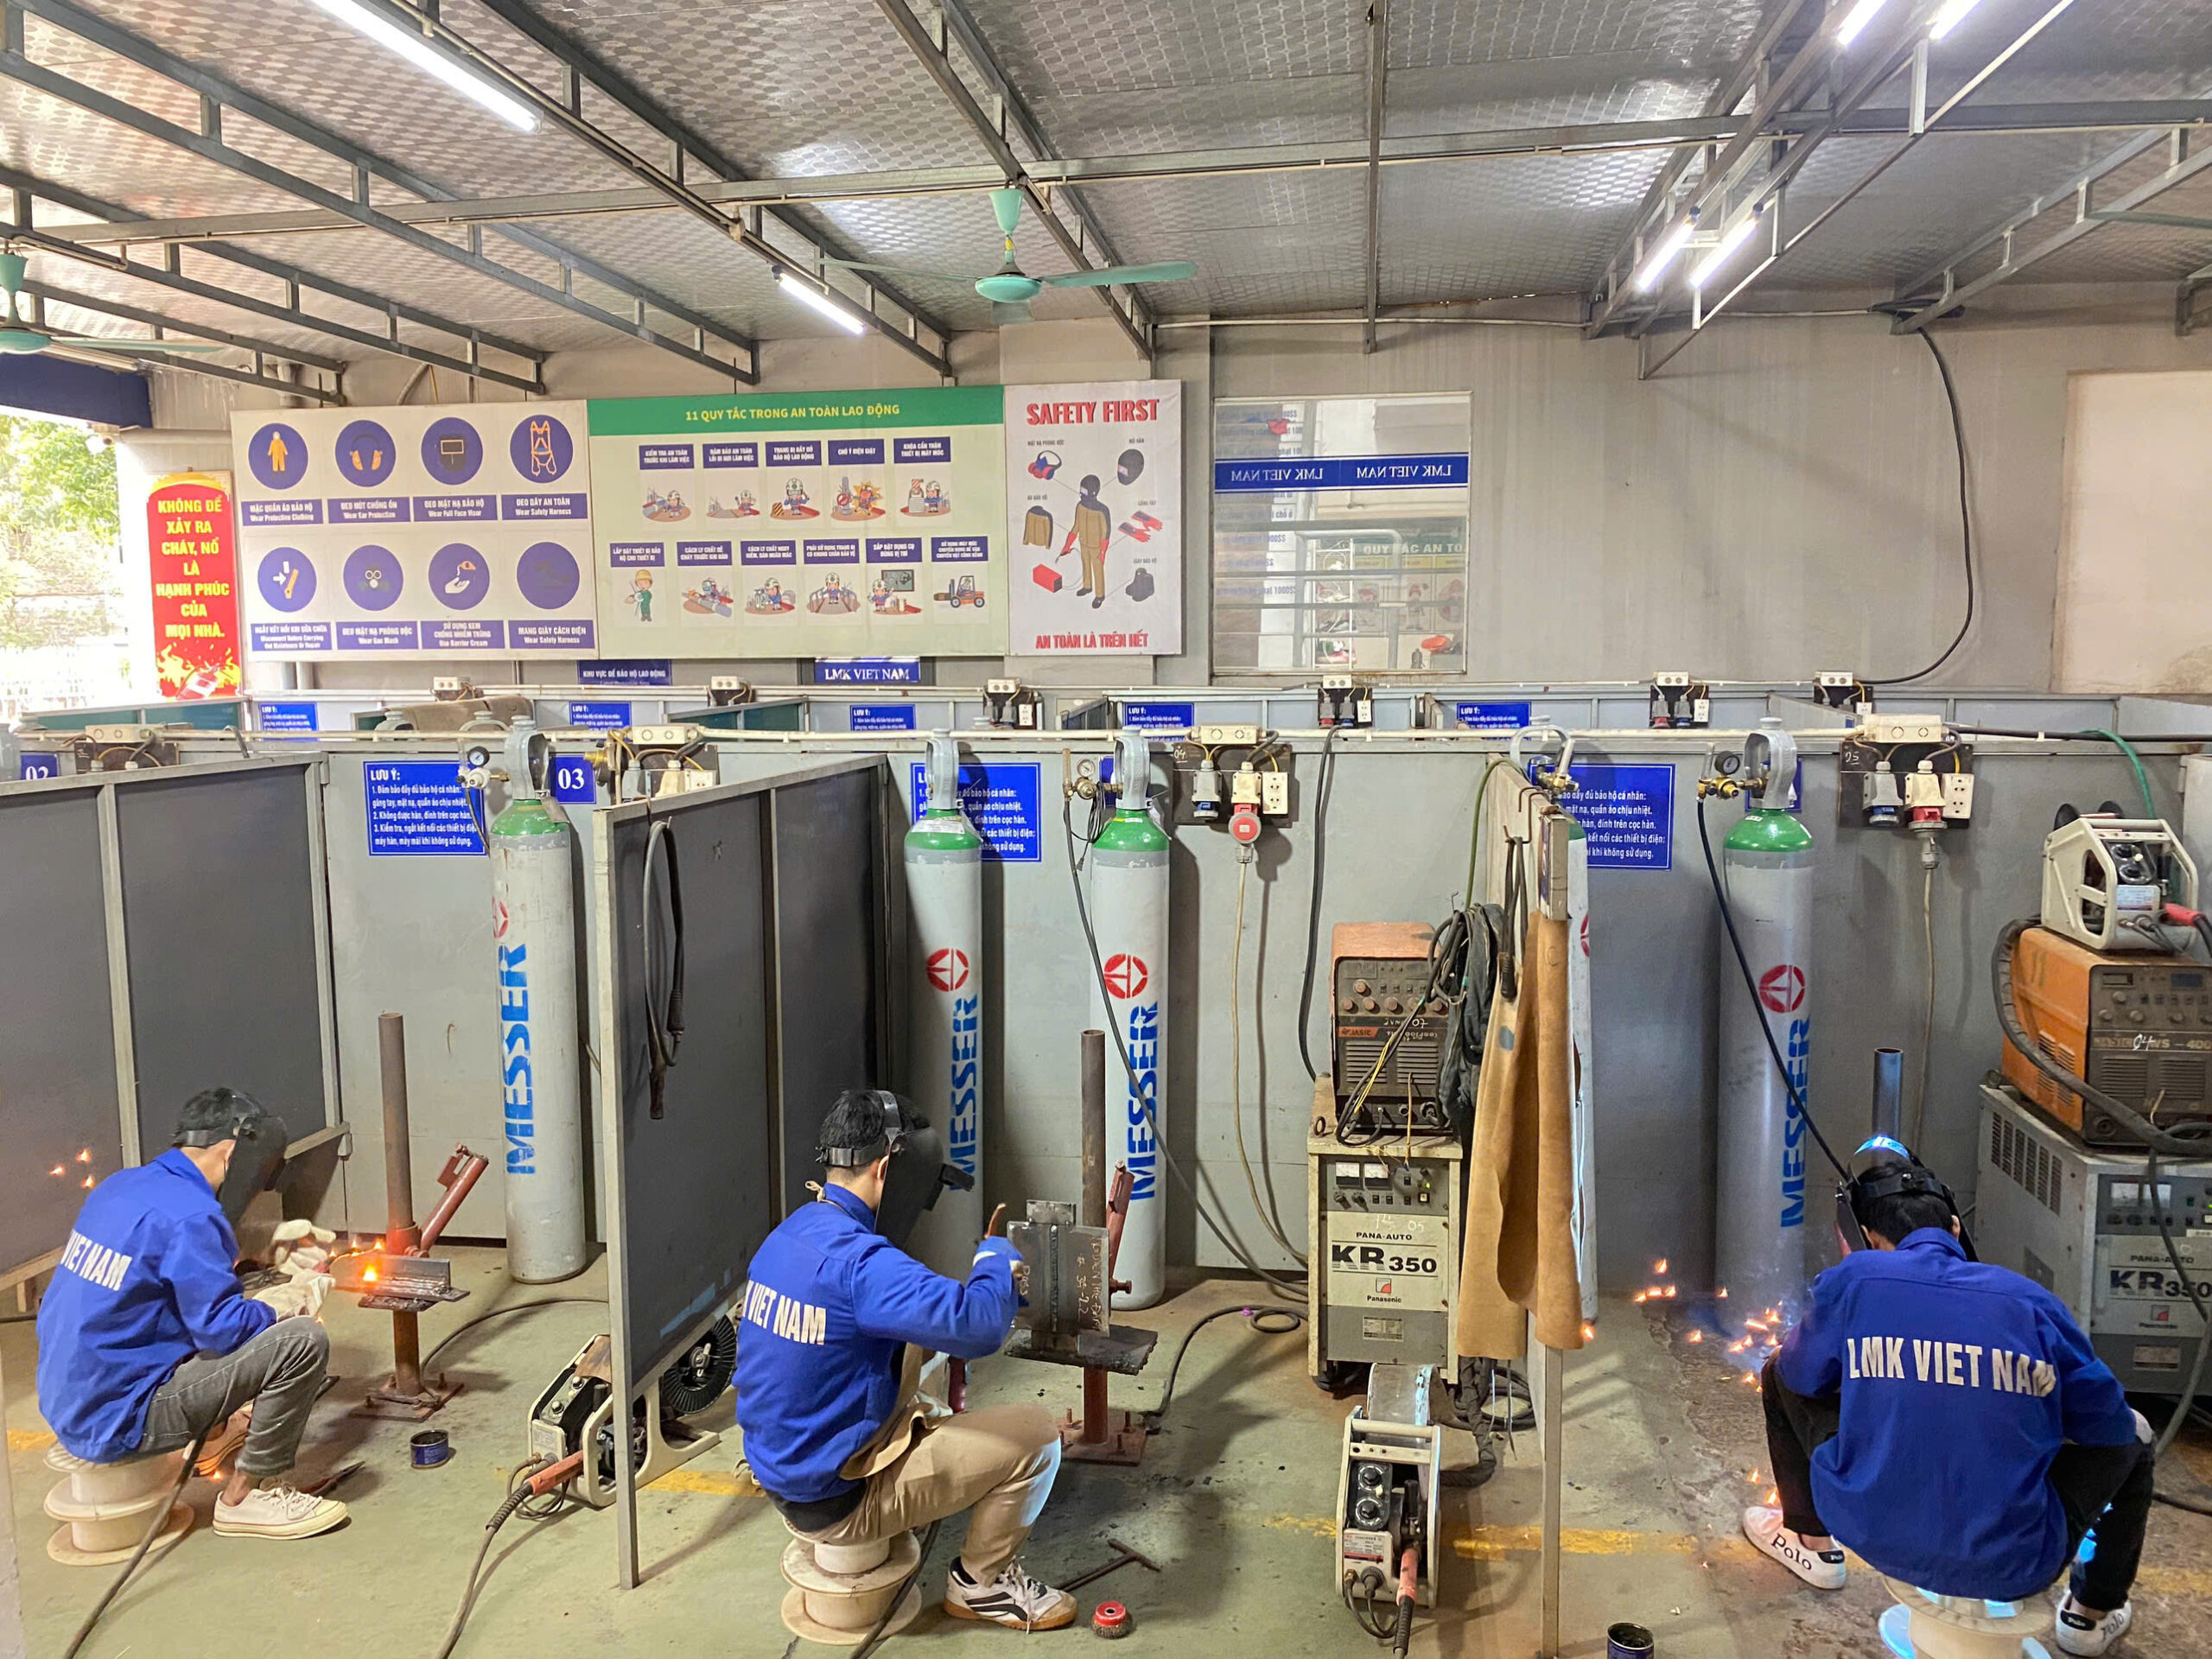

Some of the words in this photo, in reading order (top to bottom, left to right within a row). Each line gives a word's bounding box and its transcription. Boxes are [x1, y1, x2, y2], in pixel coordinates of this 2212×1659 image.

[685, 410, 698, 421] 11
[701, 410, 723, 423] QUY
[725, 405, 748, 420] TẮC
[750, 408, 788, 419] TRONG
[791, 407, 807, 418] AN
[809, 404, 840, 417] TOÀN
[842, 405, 864, 416] LAO
[867, 403, 900, 418] ĐỘNG
[1026, 401, 1097, 426] SAFETY
[1103, 398, 1160, 423] FIRST
[158, 498, 202, 513] KHÔNG
[206, 494, 223, 512] ĐỂ
[167, 517, 192, 534] XẢY
[195, 521, 212, 533] RA
[162, 539, 197, 556] CHÁY,
[200, 537, 219, 555] NỔ
[183, 560, 200, 575] LÀ
[156, 583, 192, 598] HẠNH
[195, 581, 230, 595] PHÚC
[181, 600, 207, 617] CỦA
[165, 625, 191, 640] MỌI
[194, 622, 225, 638] NHÀ.
[1035, 634, 1052, 650] AN
[1052, 632, 1081, 649] TOÀN
[1083, 631, 1097, 648] LÀ
[1098, 630, 1127, 648] TRÊN
[1128, 628, 1148, 647] HẾT
[824, 668, 850, 680] LMK
[853, 668, 880, 680] VIET
[881, 668, 910, 680] NAM
[370, 769, 389, 781] LƯU
[391, 767, 401, 781] Ý:
[558, 768, 585, 790] 03
[1585, 791, 1594, 800] đủ
[1594, 791, 1607, 800] bảo
[1608, 791, 1617, 802] hộ
[1618, 791, 1626, 800] cá
[1627, 791, 1647, 800] nhân:
[1581, 819, 1597, 830] hàn,
[1598, 819, 1613, 829] đính
[1613, 820, 1628, 829] trên
[1628, 822, 1640, 831] cọc
[1642, 820, 1656, 830] hàn.
[1587, 833, 1599, 842] kết
[1599, 833, 1610, 842] nối
[1611, 834, 1623, 843] các
[1624, 833, 1640, 843] thiết
[1640, 834, 1648, 845] bị
[1648, 834, 1666, 845] điện:
[1592, 848, 1603, 856] khi
[1604, 848, 1624, 859] không
[1625, 846, 1634, 857] sử
[1634, 849, 1654, 860] dụng.
[498, 944, 536, 1174] MESSER
[950, 994, 978, 1191] MESSER
[1128, 1001, 1159, 1201] MESSER
[1780, 1014, 1811, 1228] MESSER
[1356, 1231, 1413, 1241] PANA-AUTO
[79, 1243, 132, 1291] NAM
[1332, 1244, 1386, 1271] KR
[1389, 1256, 1437, 1274] 350
[2131, 1255, 2195, 1263] PANA-ATO
[2110, 1270, 2164, 1296] KR
[1367, 1295, 1402, 1304] Panasonic
[747, 1281, 778, 1329] VIET
[772, 1294, 826, 1345] NAM
[1847, 1336, 1905, 1379] LMK
[1912, 1338, 1983, 1388] VIET
[1770, 1533, 1812, 1572] Polo
